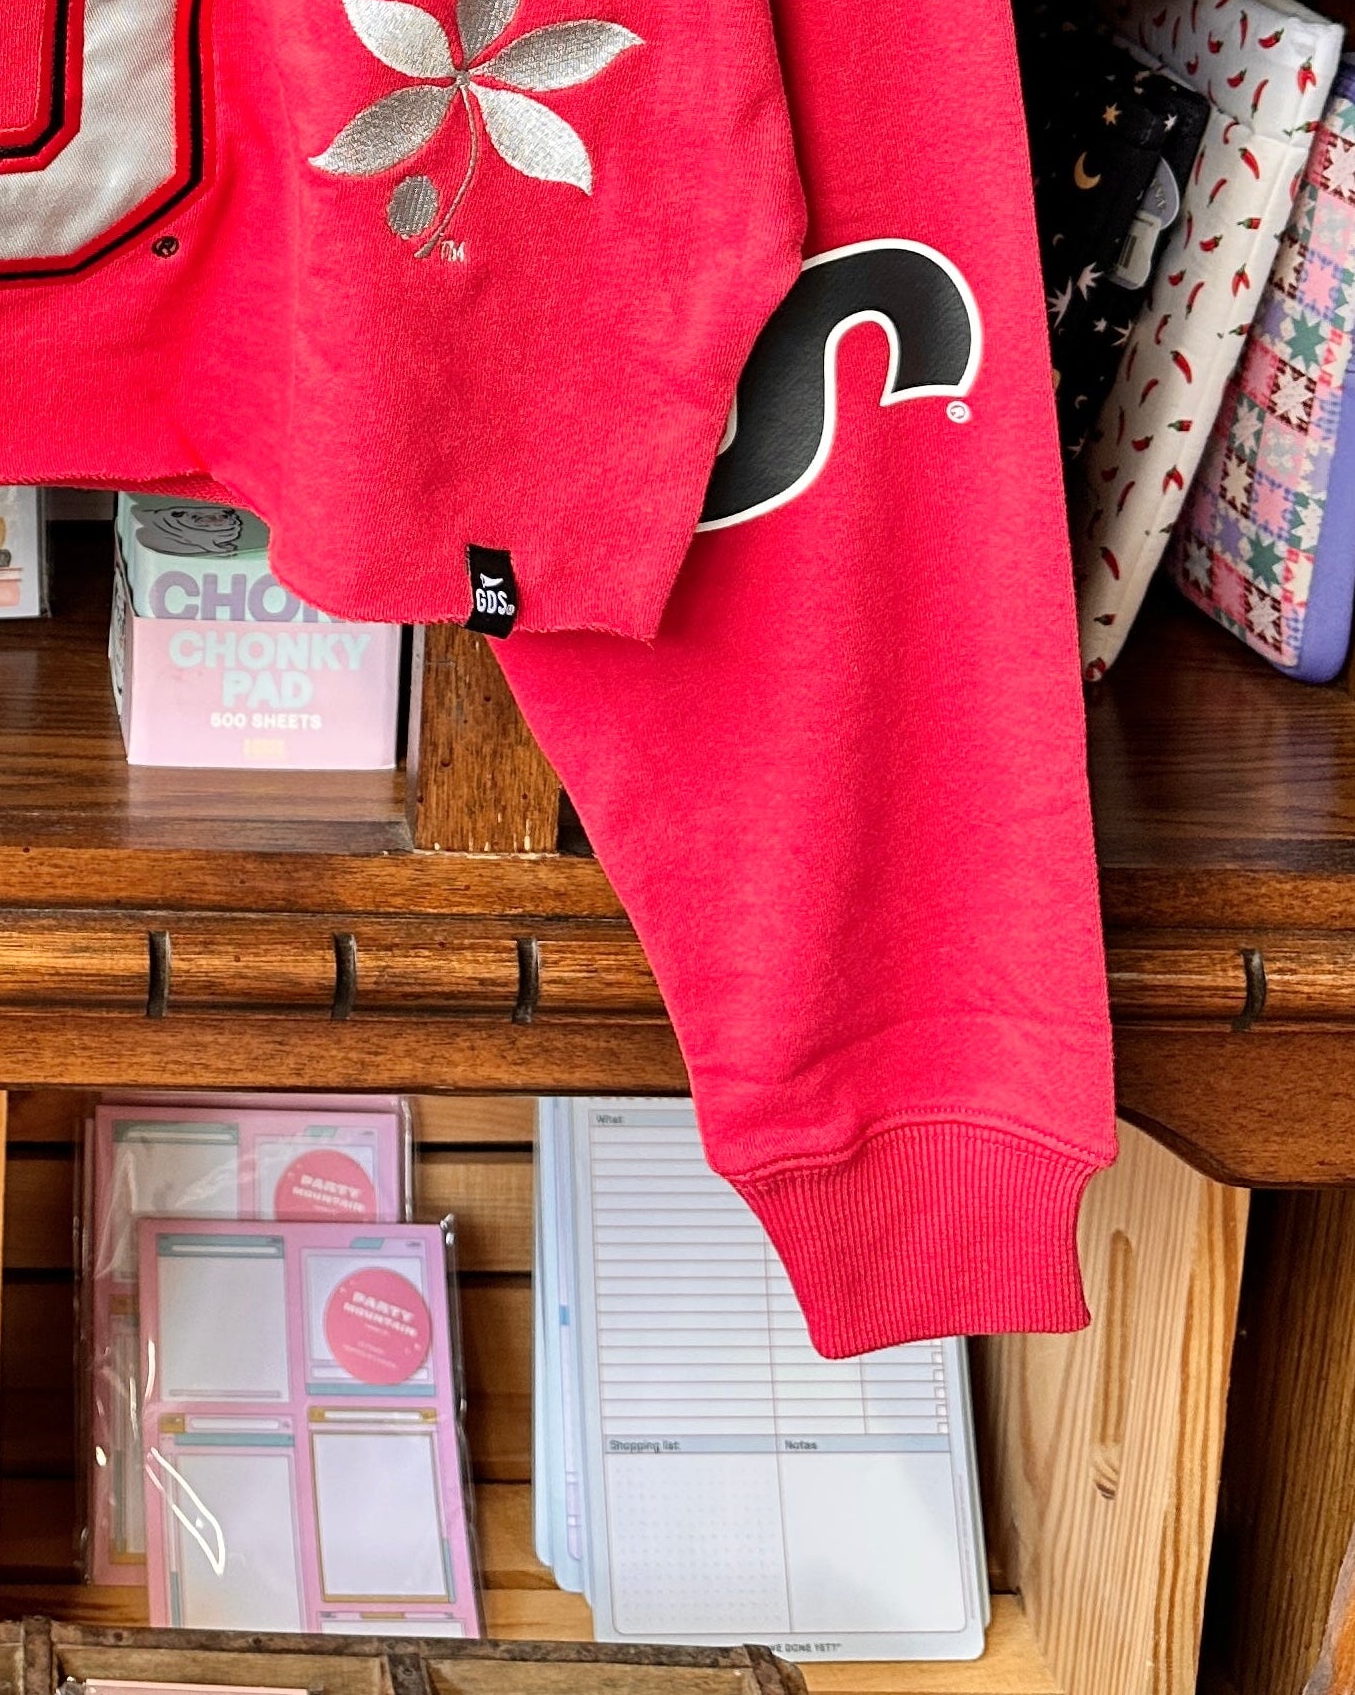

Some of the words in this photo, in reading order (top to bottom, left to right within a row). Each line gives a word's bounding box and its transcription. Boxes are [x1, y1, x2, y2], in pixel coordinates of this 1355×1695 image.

[149, 570, 346, 624] CHO
[475, 588, 508, 615] GDS
[169, 629, 372, 671] CHONKY
[221, 670, 315, 709] PAD
[210, 712, 246, 729] 500
[251, 713, 323, 730] SHEETS
[291, 1185, 366, 1214] MOUNTAIN
[300, 1173, 362, 1199] PARTY
[343, 1302, 418, 1338] MOUNTAIN
[352, 1290, 415, 1322] PARTY
[609, 1439, 660, 1453] Shopping
[784, 1439, 818, 1450] Notes
